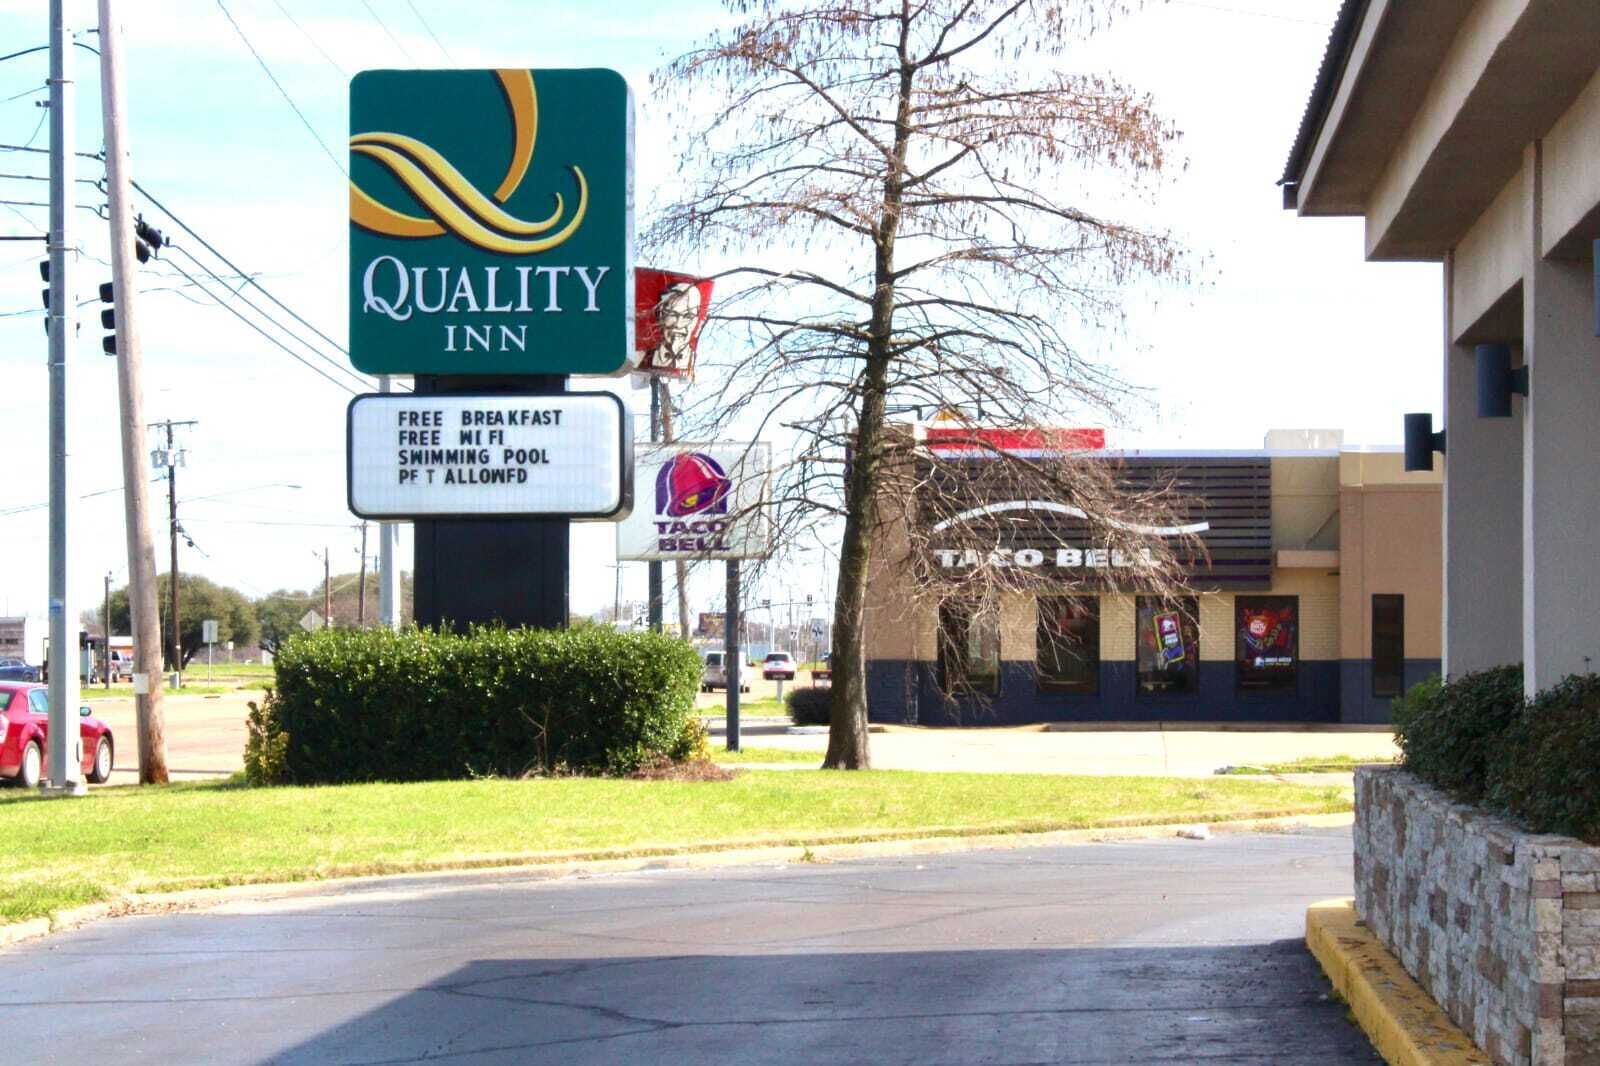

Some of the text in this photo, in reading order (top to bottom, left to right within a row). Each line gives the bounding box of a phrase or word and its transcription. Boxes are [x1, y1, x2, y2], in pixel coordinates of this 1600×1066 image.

[363, 255, 610, 321] QUALITY
[444, 325, 528, 352] INN
[399, 410, 562, 426] FREE BREAKFAST
[399, 430, 440, 445] FREE
[399, 449, 549, 465] SWIMMING POOL
[653, 521, 727, 534] TACO
[659, 538, 730, 551] BELL
[934, 548, 1043, 567] TACO
